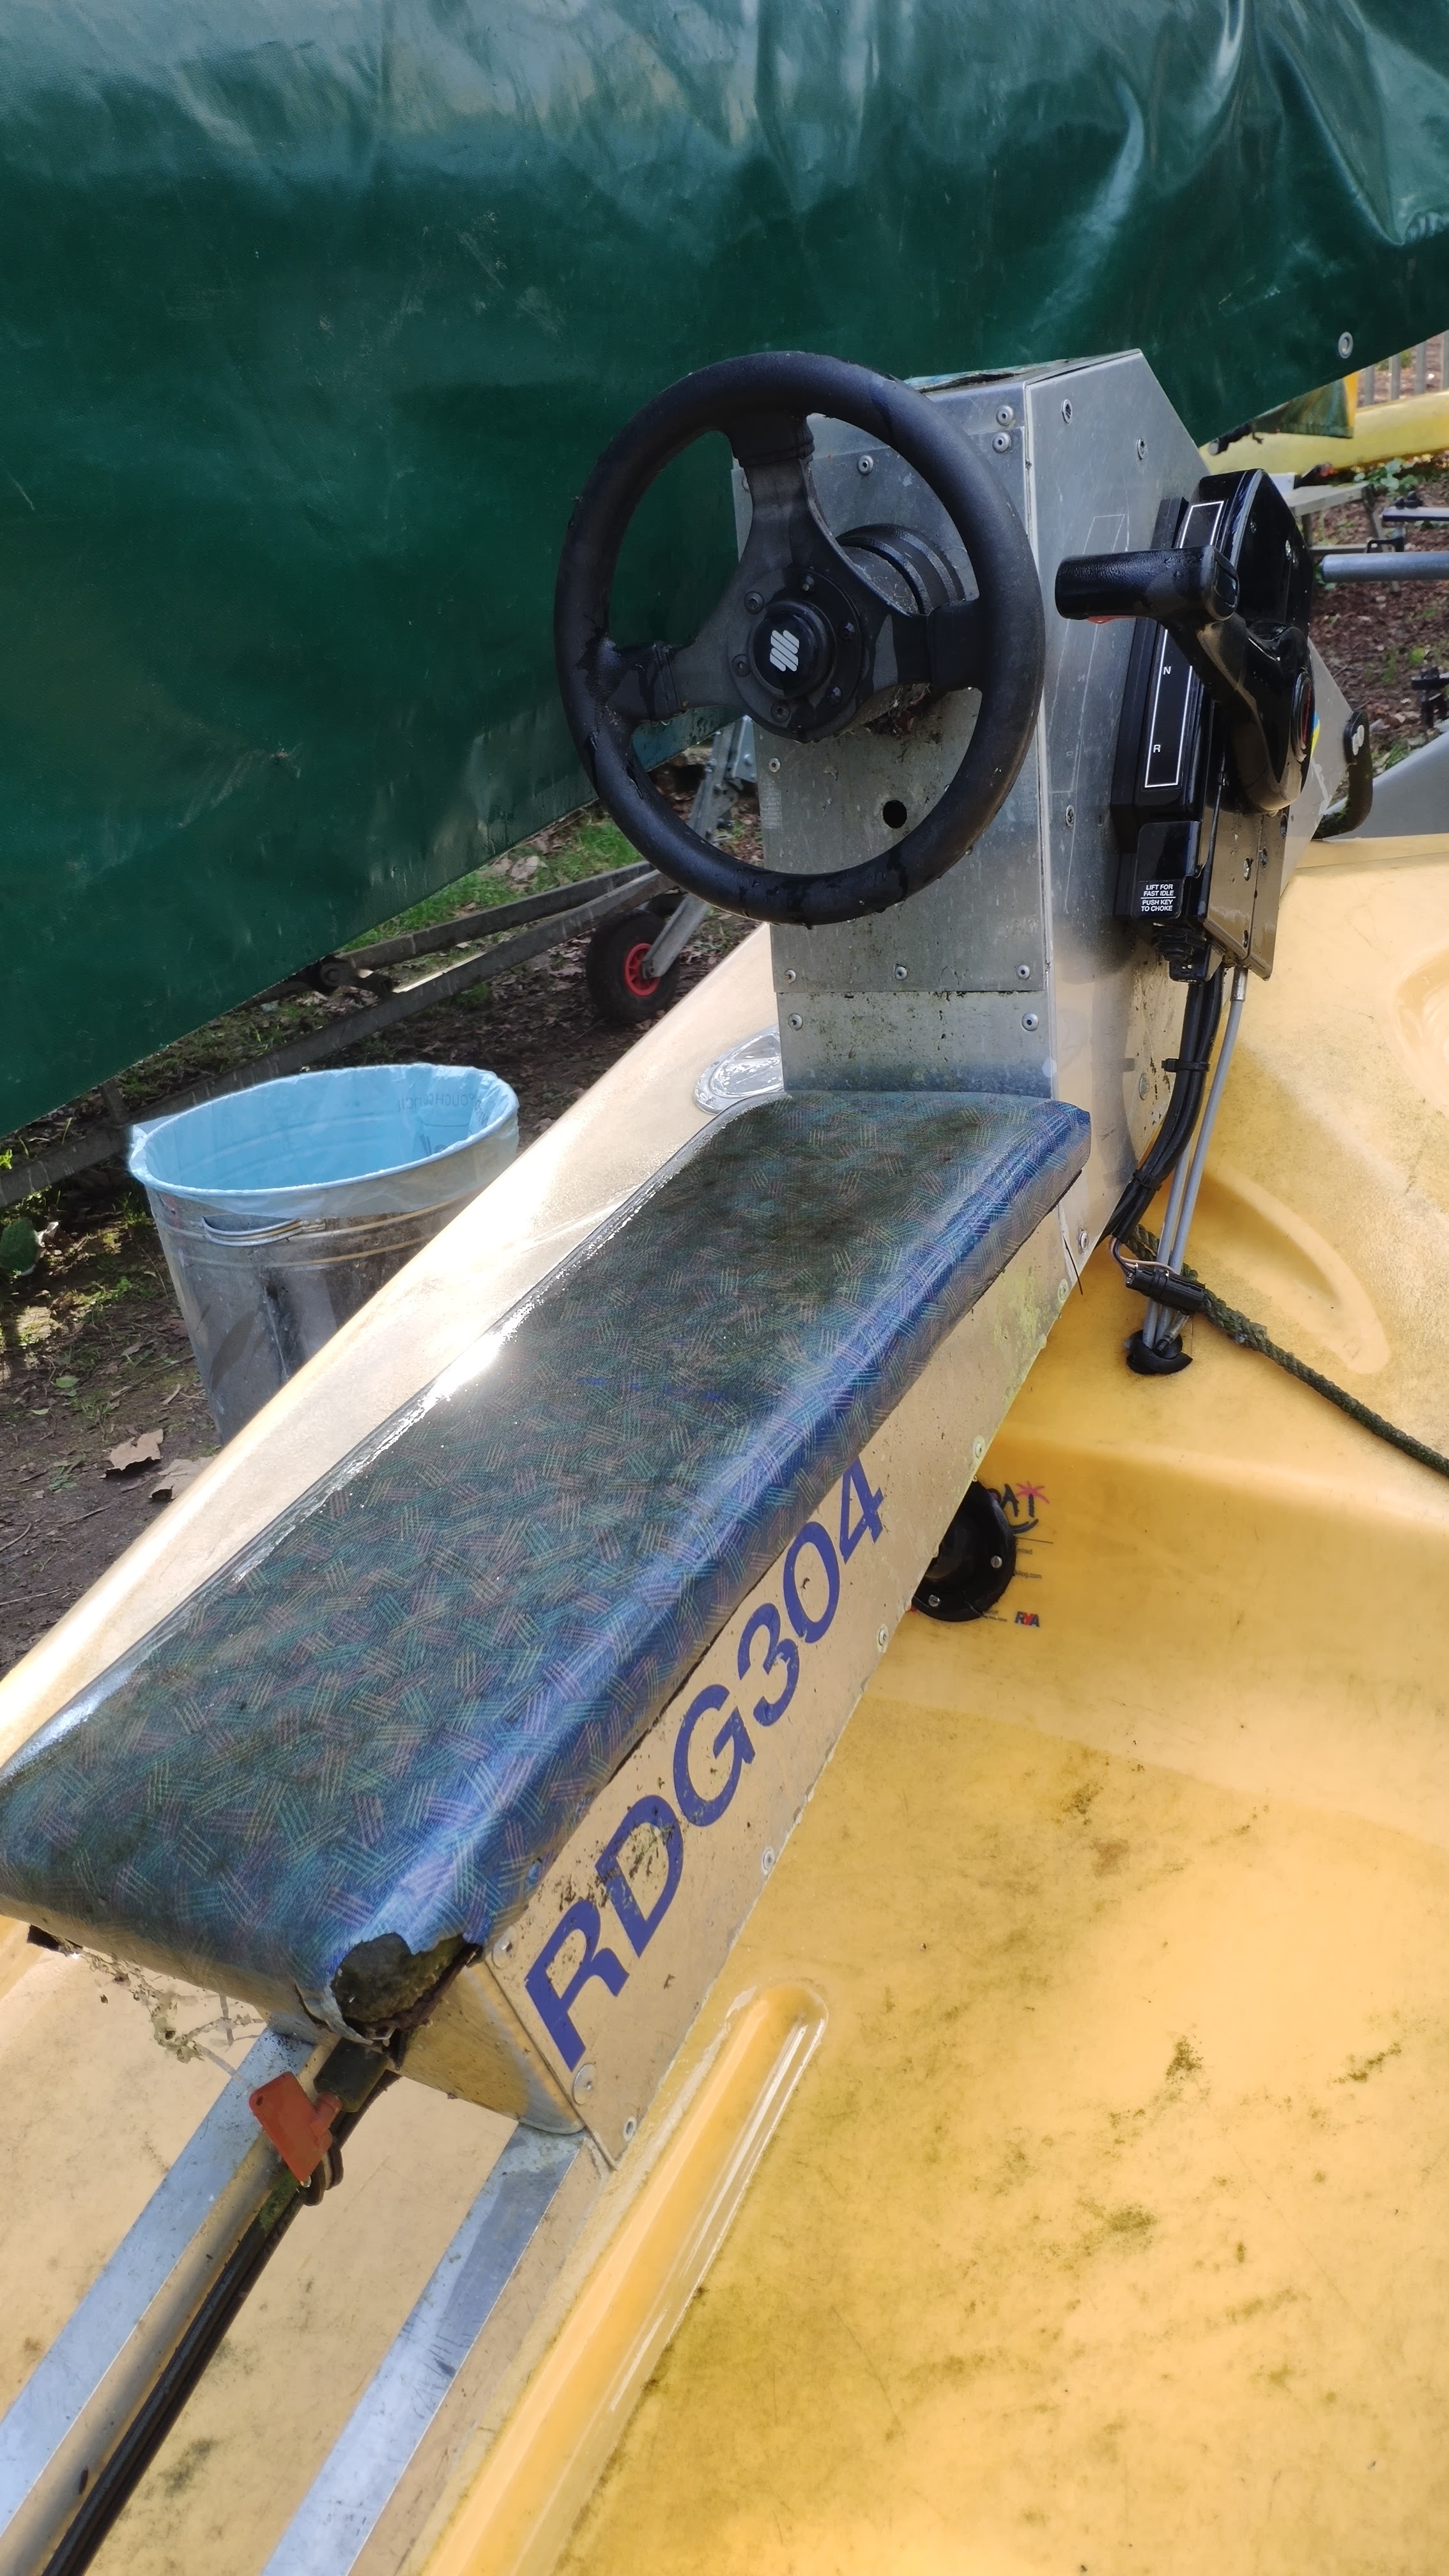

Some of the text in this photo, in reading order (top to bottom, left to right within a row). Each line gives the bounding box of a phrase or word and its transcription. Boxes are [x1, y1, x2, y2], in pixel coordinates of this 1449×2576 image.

[1163, 666, 1171, 675] N
[1153, 744, 1161, 753] R
[1015, 1611, 1040, 1628] RYA
[524, 1455, 886, 2071] RDG304
